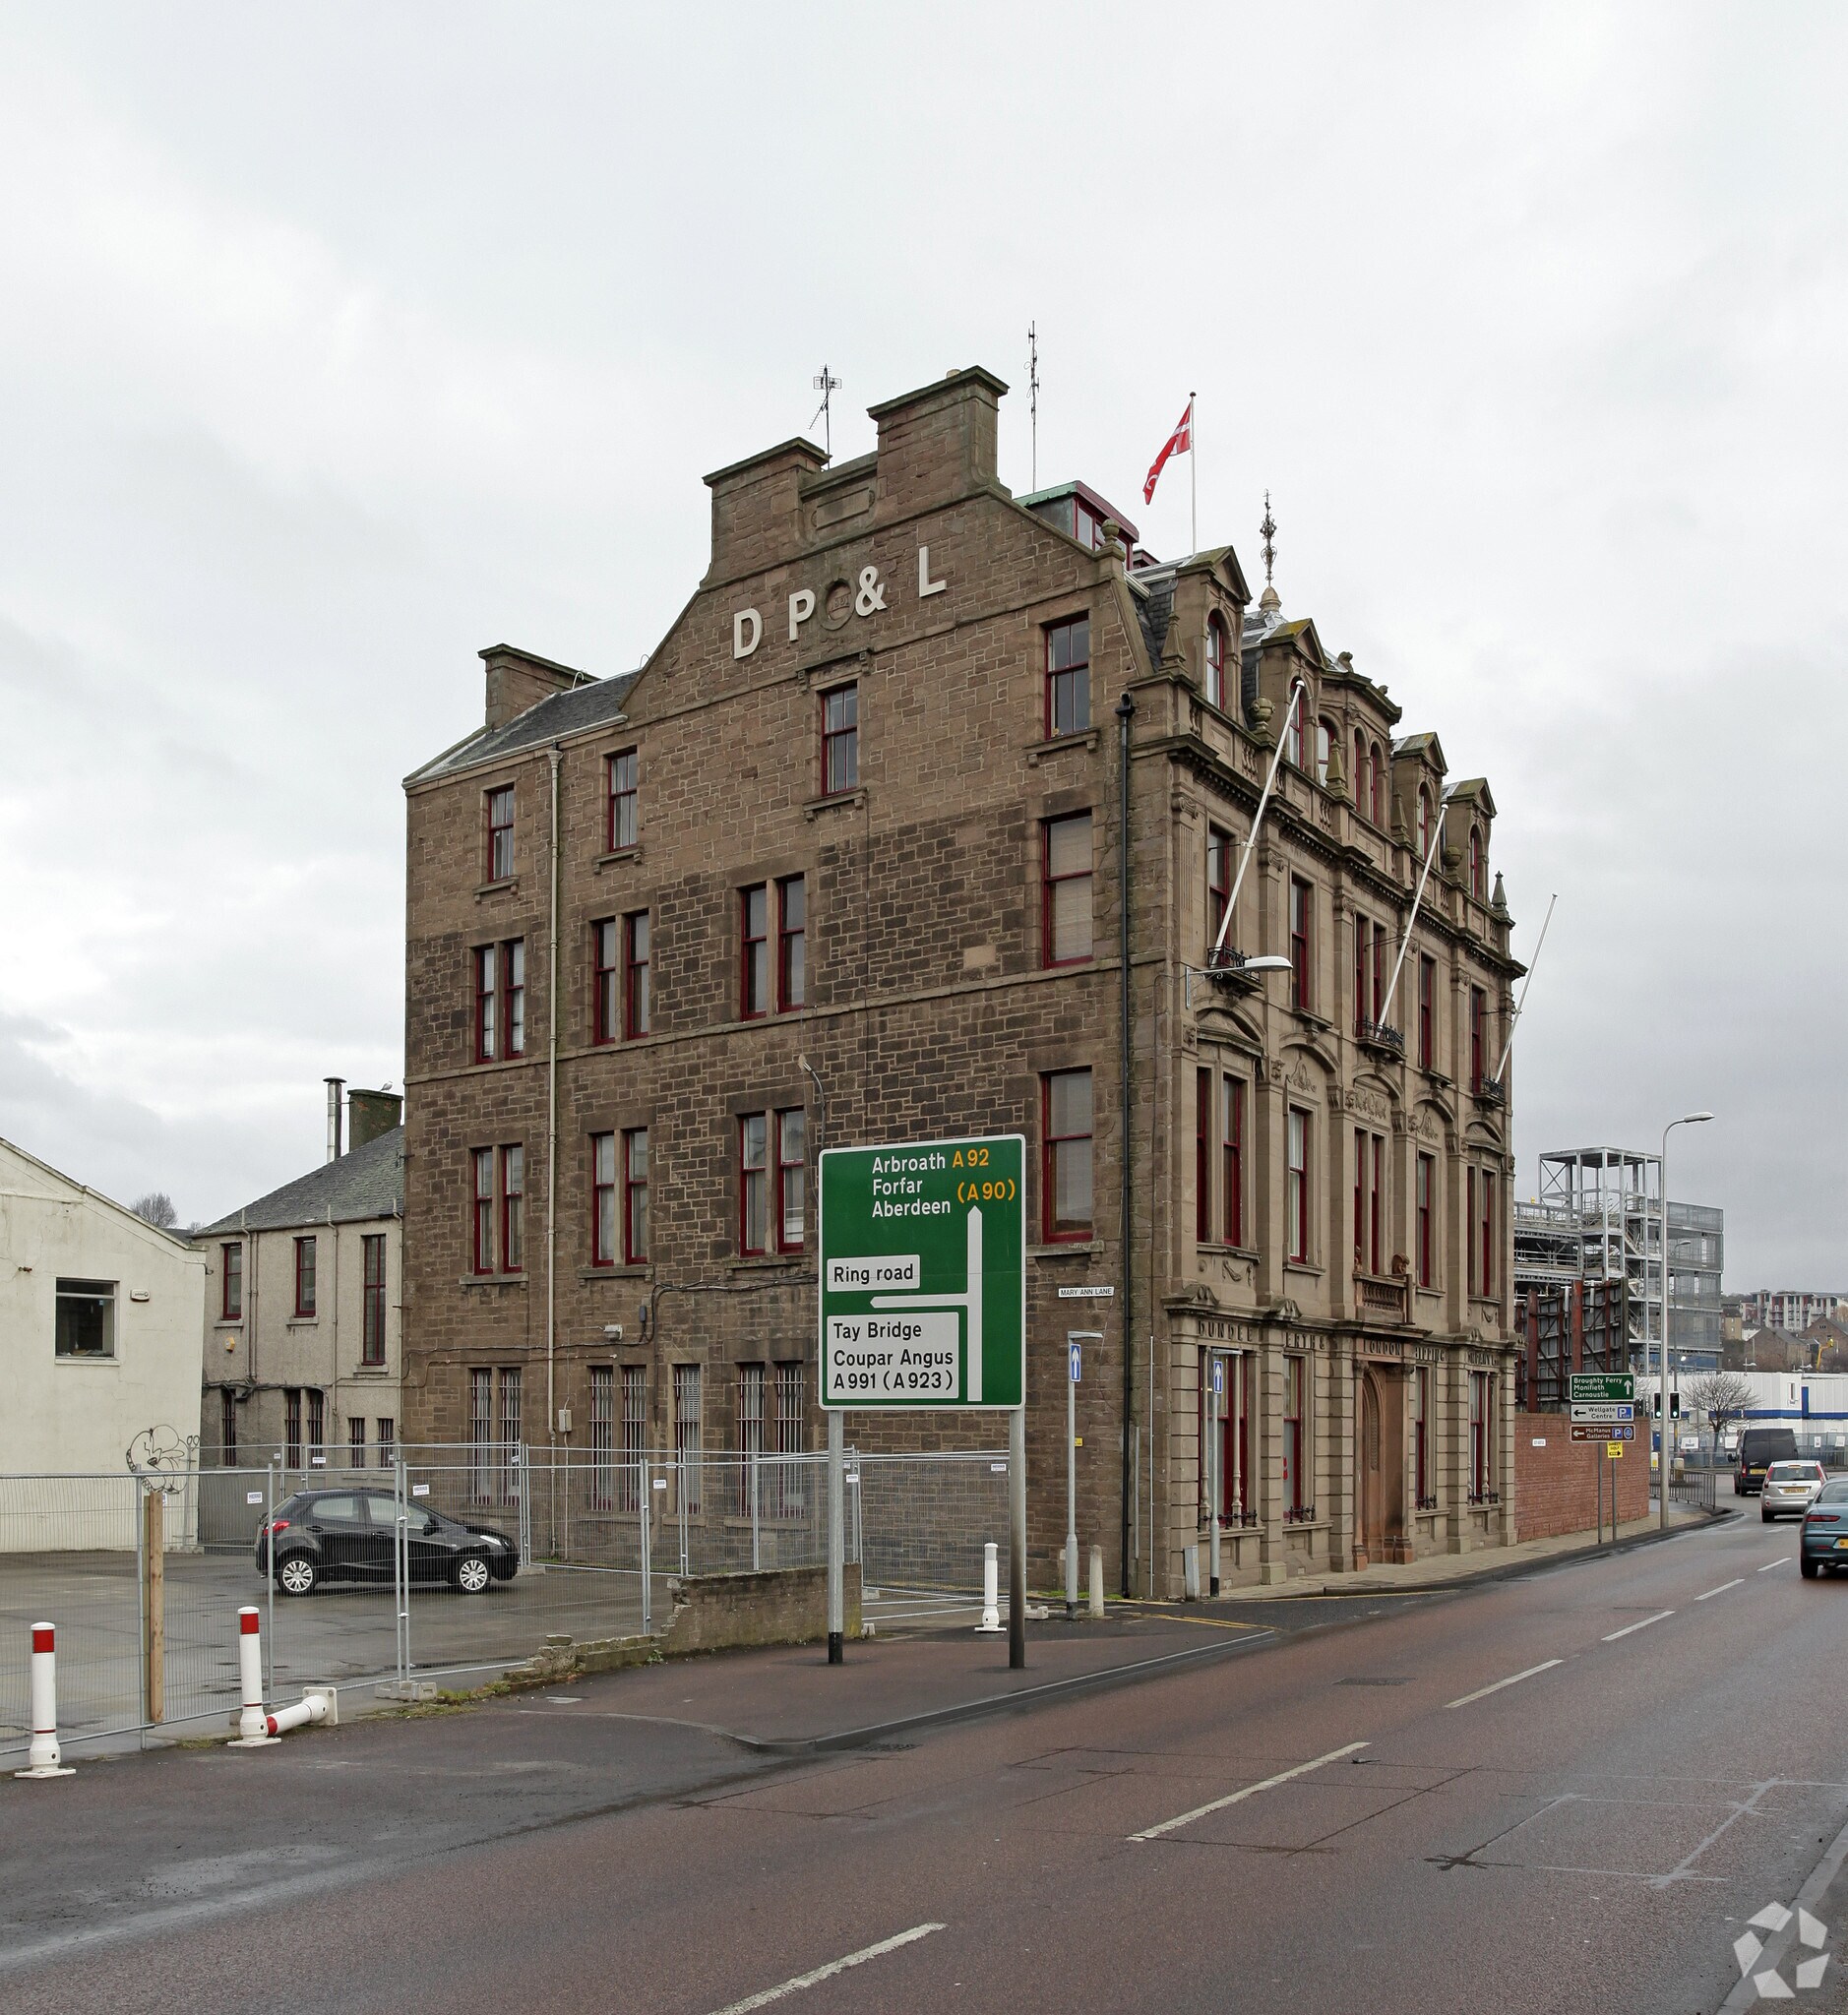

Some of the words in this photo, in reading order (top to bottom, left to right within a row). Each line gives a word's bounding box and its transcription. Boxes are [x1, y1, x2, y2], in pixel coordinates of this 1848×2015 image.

[733, 608, 763, 659] D
[789, 588, 816, 641] P
[855, 566, 887, 617] &
[918, 545, 947, 598] L
[872, 1152, 946, 1174] Arbroath
[953, 1148, 989, 1169] A92
[873, 1177, 923, 1195] Forfar
[957, 1179, 1016, 1203] (A90)
[872, 1198, 951, 1218] Aberdeen
[833, 1266, 870, 1285] Ring
[877, 1263, 913, 1280] road
[833, 1322, 860, 1342] Tay
[868, 1321, 922, 1340] Bridge
[1199, 1320, 1253, 1342] DUNDEE
[1285, 1332, 1315, 1350] ERTH
[1363, 1338, 1401, 1356] LONDON
[1415, 1346, 1447, 1362] HIPPING
[833, 1350, 893, 1369] Coupar
[900, 1349, 954, 1369] Angus
[833, 1373, 876, 1389] A991
[883, 1370, 953, 1391] (A923)
[1619, 1408, 1627, 1418] P
[1615, 1429, 1622, 1438] P
